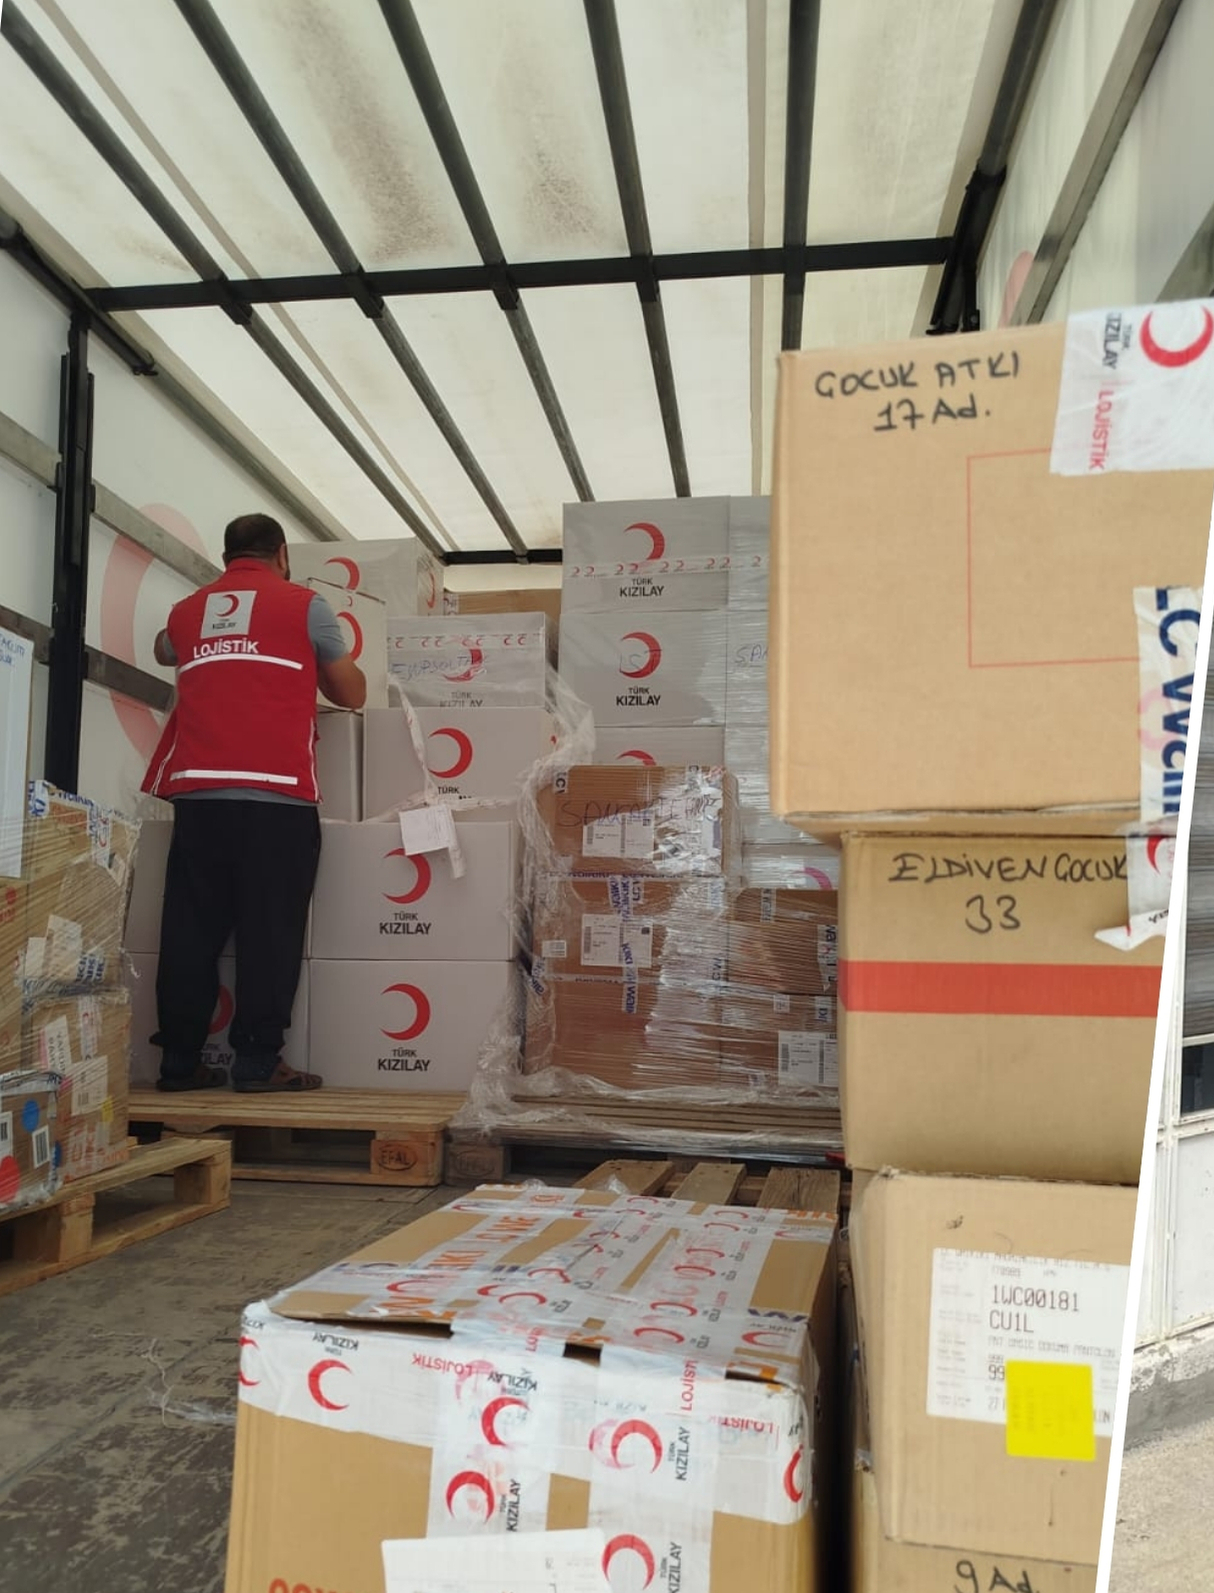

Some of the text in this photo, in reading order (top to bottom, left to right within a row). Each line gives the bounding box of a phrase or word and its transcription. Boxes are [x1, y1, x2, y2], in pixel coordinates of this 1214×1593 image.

[873, 401, 924, 432] 17
[619, 585, 665, 598] KIZILAY
[193, 637, 259, 660] LOJİSTİK
[616, 695, 662, 707] KIZILAY
[394, 911, 418, 921] TÜRK
[379, 922, 432, 935] KIZILAY
[392, 1046, 418, 1058] TÜRK
[377, 1057, 431, 1072] KIZILAY
[991, 1284, 1080, 1312] 1WC00181
[312, 1331, 360, 1351] KIZILAY
[412, 1353, 473, 1377] LOJİSTİK
[487, 1370, 538, 1391] KIZILAY
[675, 1427, 691, 1481] KIZILAY
[506, 1479, 521, 1532] KIZILAY
